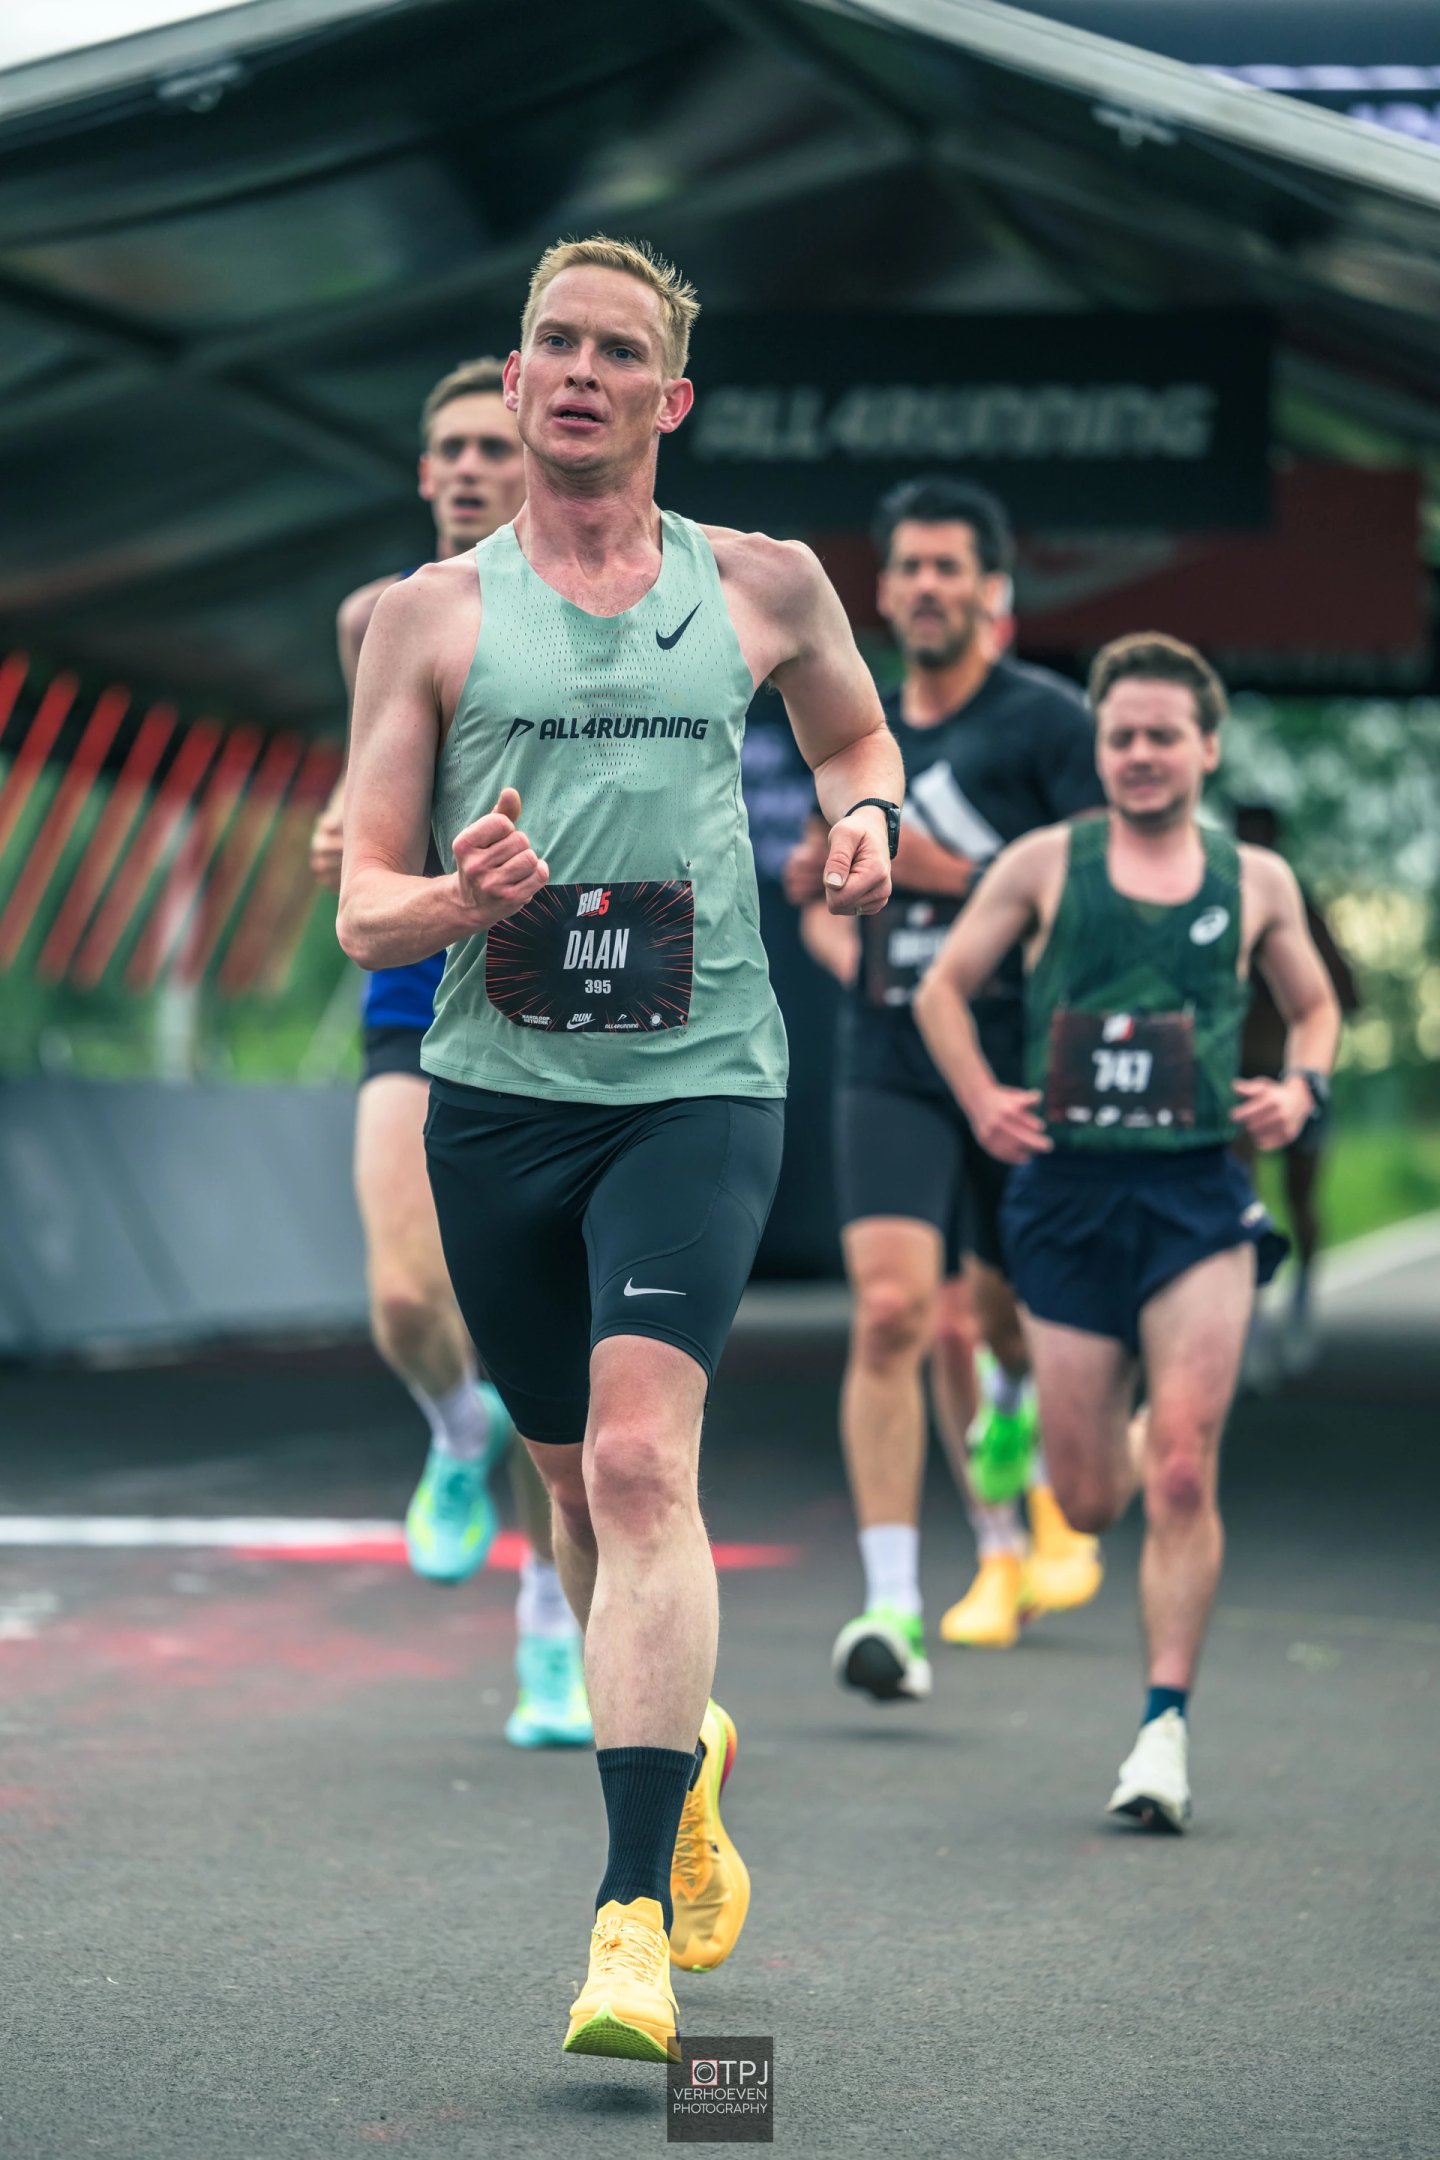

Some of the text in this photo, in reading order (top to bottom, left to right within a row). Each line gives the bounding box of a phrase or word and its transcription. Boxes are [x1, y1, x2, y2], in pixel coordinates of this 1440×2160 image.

[539, 716, 709, 740] ALL4RUNNING
[563, 928, 630, 970] DAAN
[584, 979, 611, 994] 395
[572, 1013, 592, 1022] RUN
